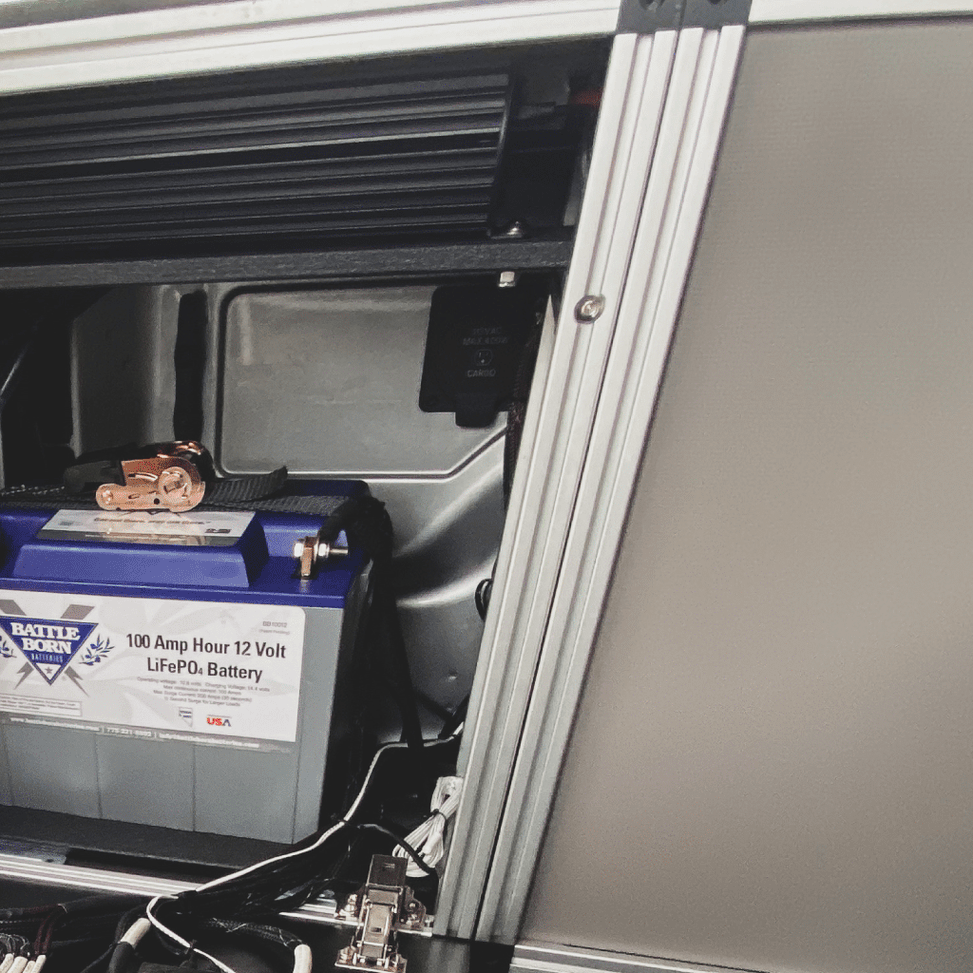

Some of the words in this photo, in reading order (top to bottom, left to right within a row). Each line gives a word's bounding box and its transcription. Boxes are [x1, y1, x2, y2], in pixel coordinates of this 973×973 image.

[10, 622, 81, 641] BATTLE
[22, 637, 72, 655] BORN
[126, 633, 150, 650] 100
[154, 634, 188, 654] Amp
[192, 637, 230, 654] Hour
[234, 640, 251, 657] 12
[256, 640, 286, 659] Volt
[207, 660, 263, 683] Battery
[206, 715, 232, 728] USA
